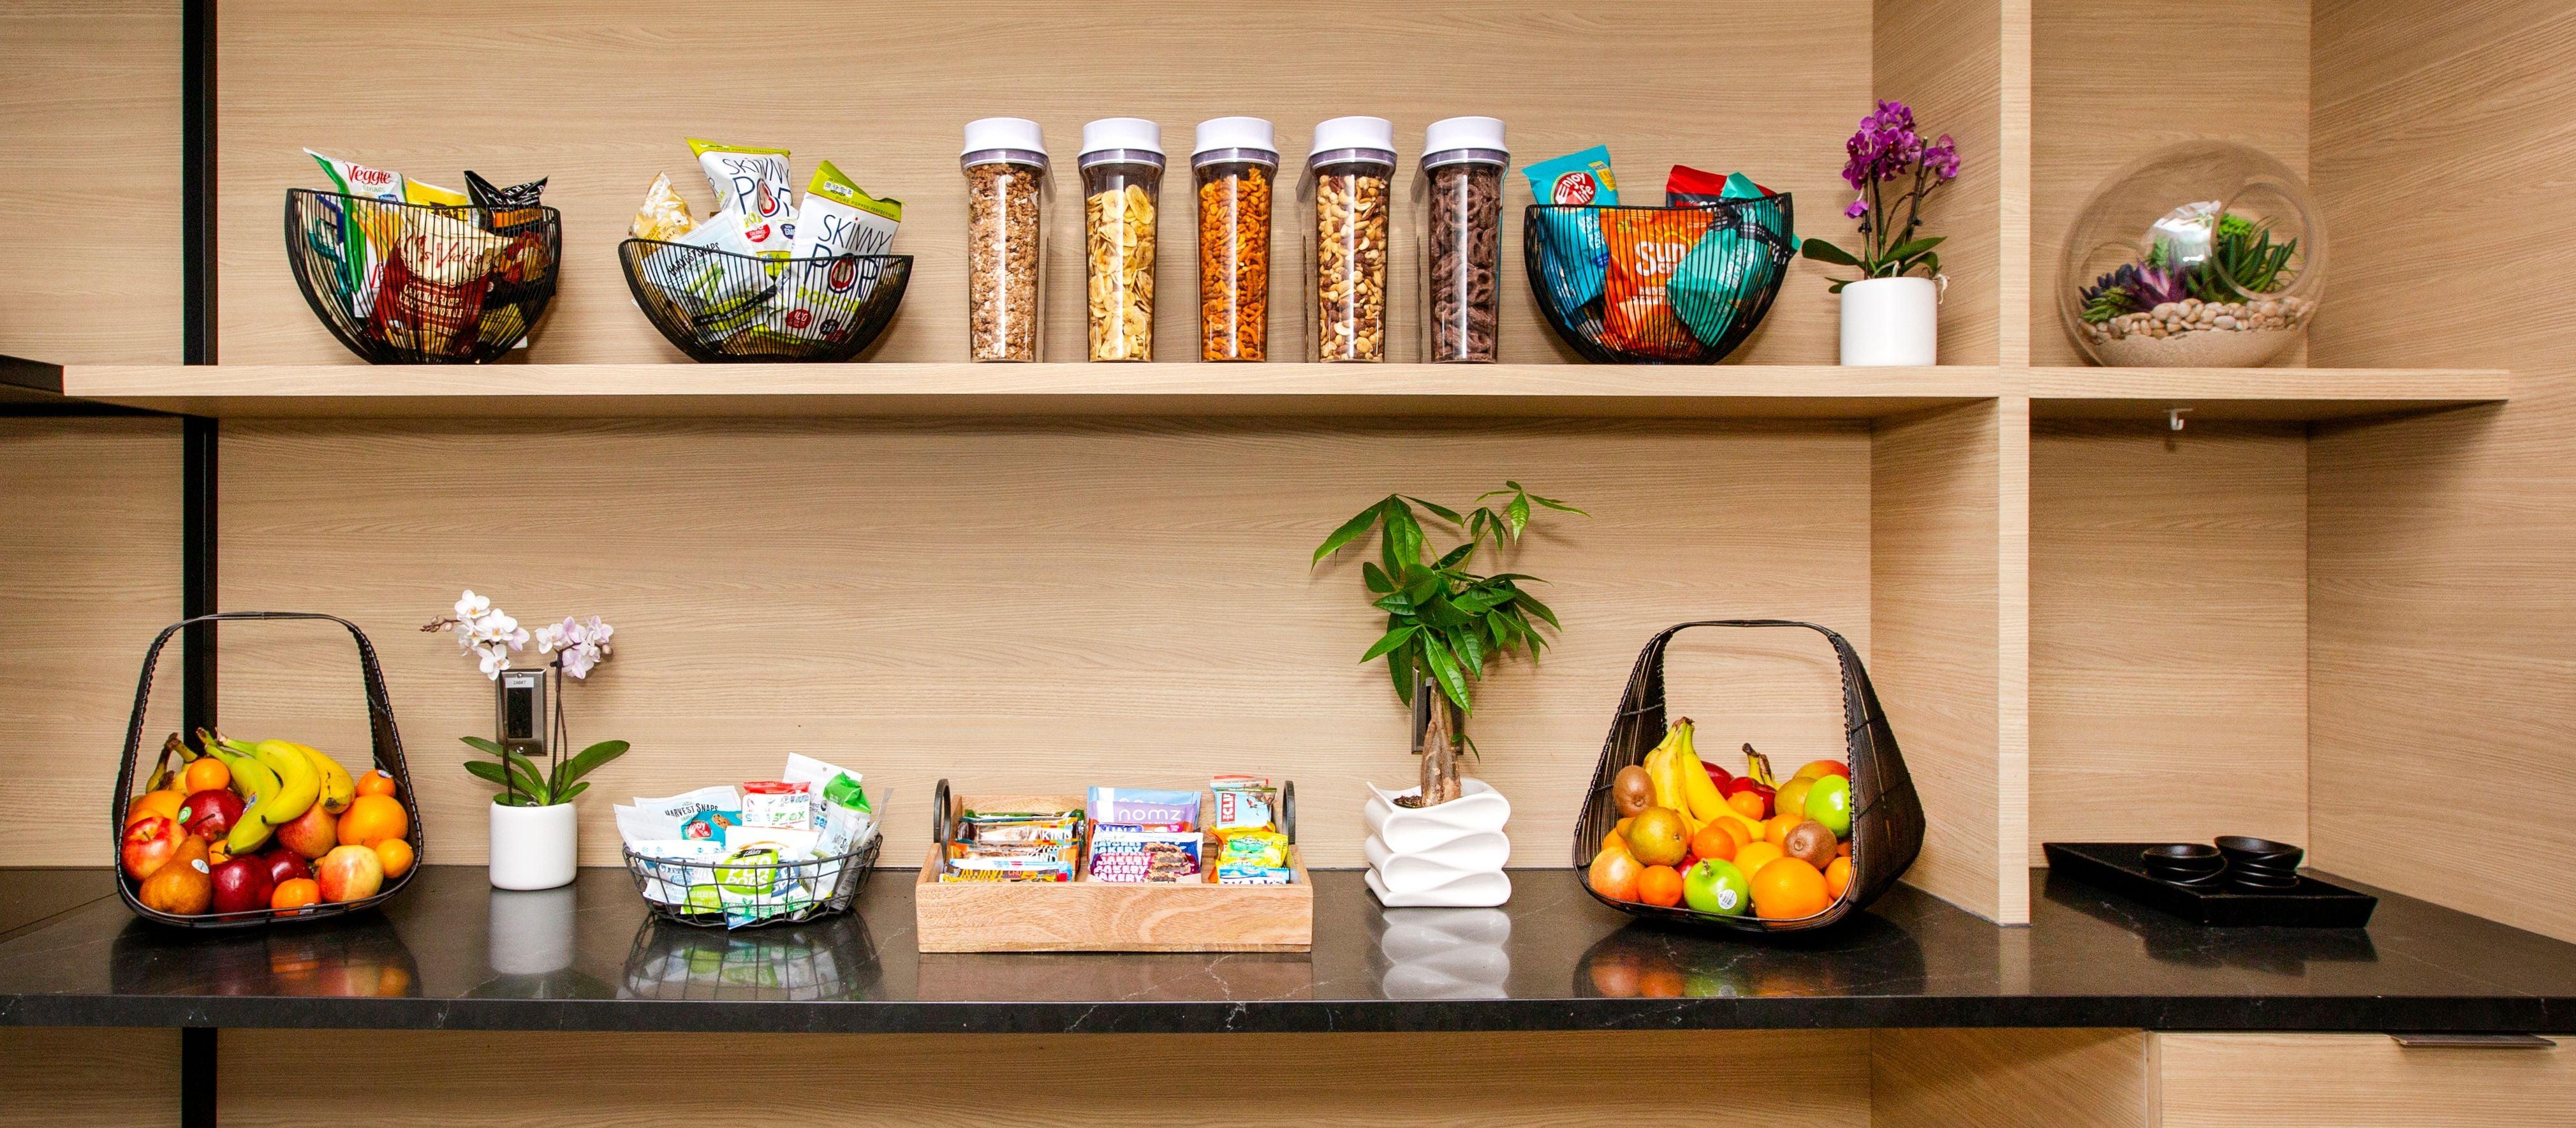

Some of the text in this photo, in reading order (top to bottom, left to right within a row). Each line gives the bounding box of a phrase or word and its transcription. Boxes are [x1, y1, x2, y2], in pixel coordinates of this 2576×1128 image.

[345, 164, 392, 185] Veggie
[835, 195, 897, 218] PURE POPPED PERFECTION
[818, 214, 893, 256] SKINNY
[1635, 240, 1687, 276] Sun
[665, 806, 695, 818] HARVEST
[1118, 809, 1182, 822] nomz
[1041, 829, 1072, 840] KIND
